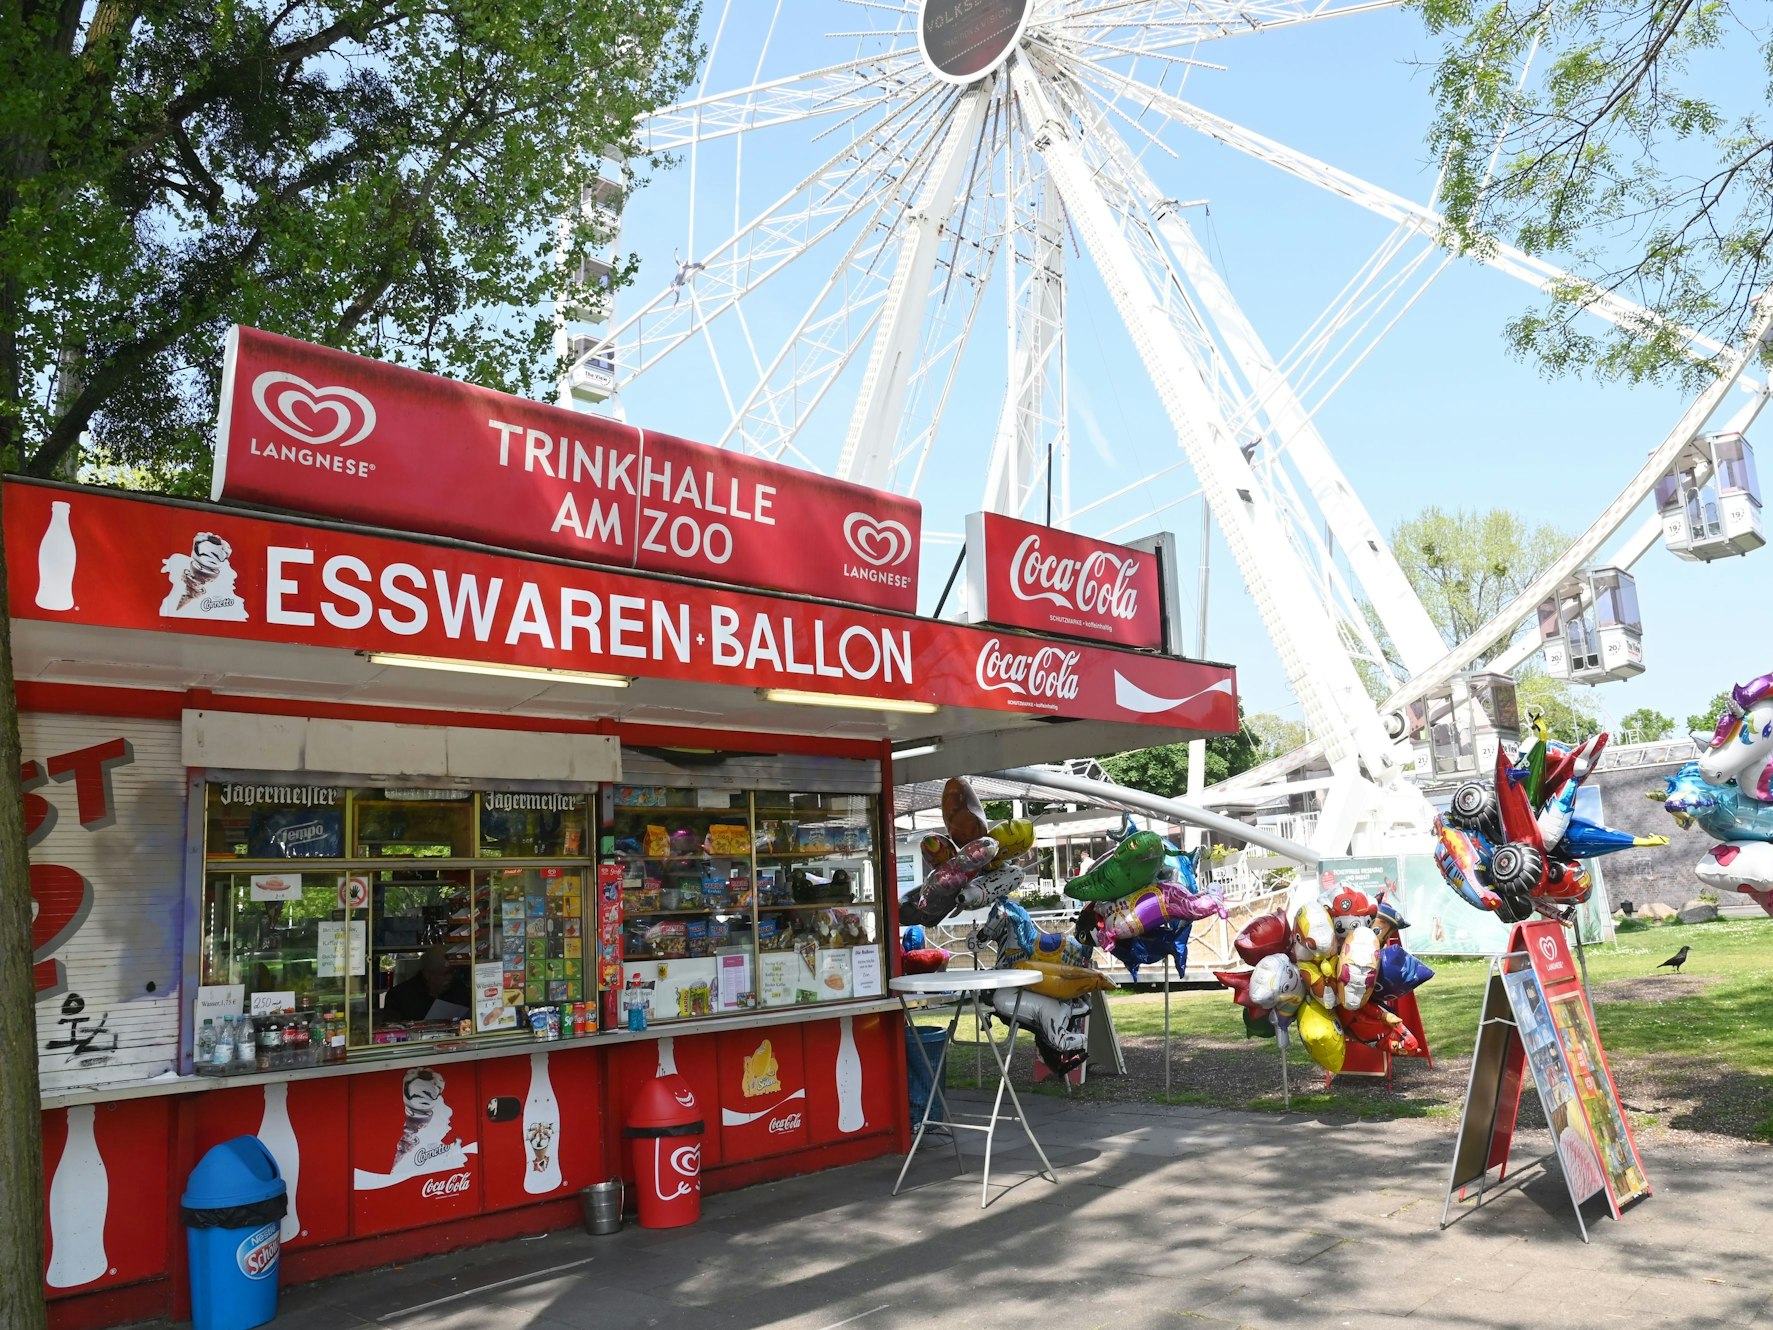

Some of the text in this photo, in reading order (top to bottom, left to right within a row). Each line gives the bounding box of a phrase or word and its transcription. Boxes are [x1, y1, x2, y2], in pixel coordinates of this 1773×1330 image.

[488, 419, 777, 526] TRINKHALLE
[1731, 511, 1741, 519] 19
[551, 491, 733, 564] AM ZOO
[1669, 524, 1678, 532] 19
[1009, 534, 1140, 620] Coca-Cola
[200, 597, 235, 612] Cornetto
[265, 546, 690, 663] ESSWAREN
[711, 605, 913, 684] BALLON
[1049, 614, 1113, 633] SCHUTZMARKE koffeinhaltig
[975, 638, 1080, 700] Coca-Cola
[282, 823, 324, 843] Tempo
[414, 1143, 450, 1166] Cornetto
[251, 1225, 276, 1247] Nestlé
